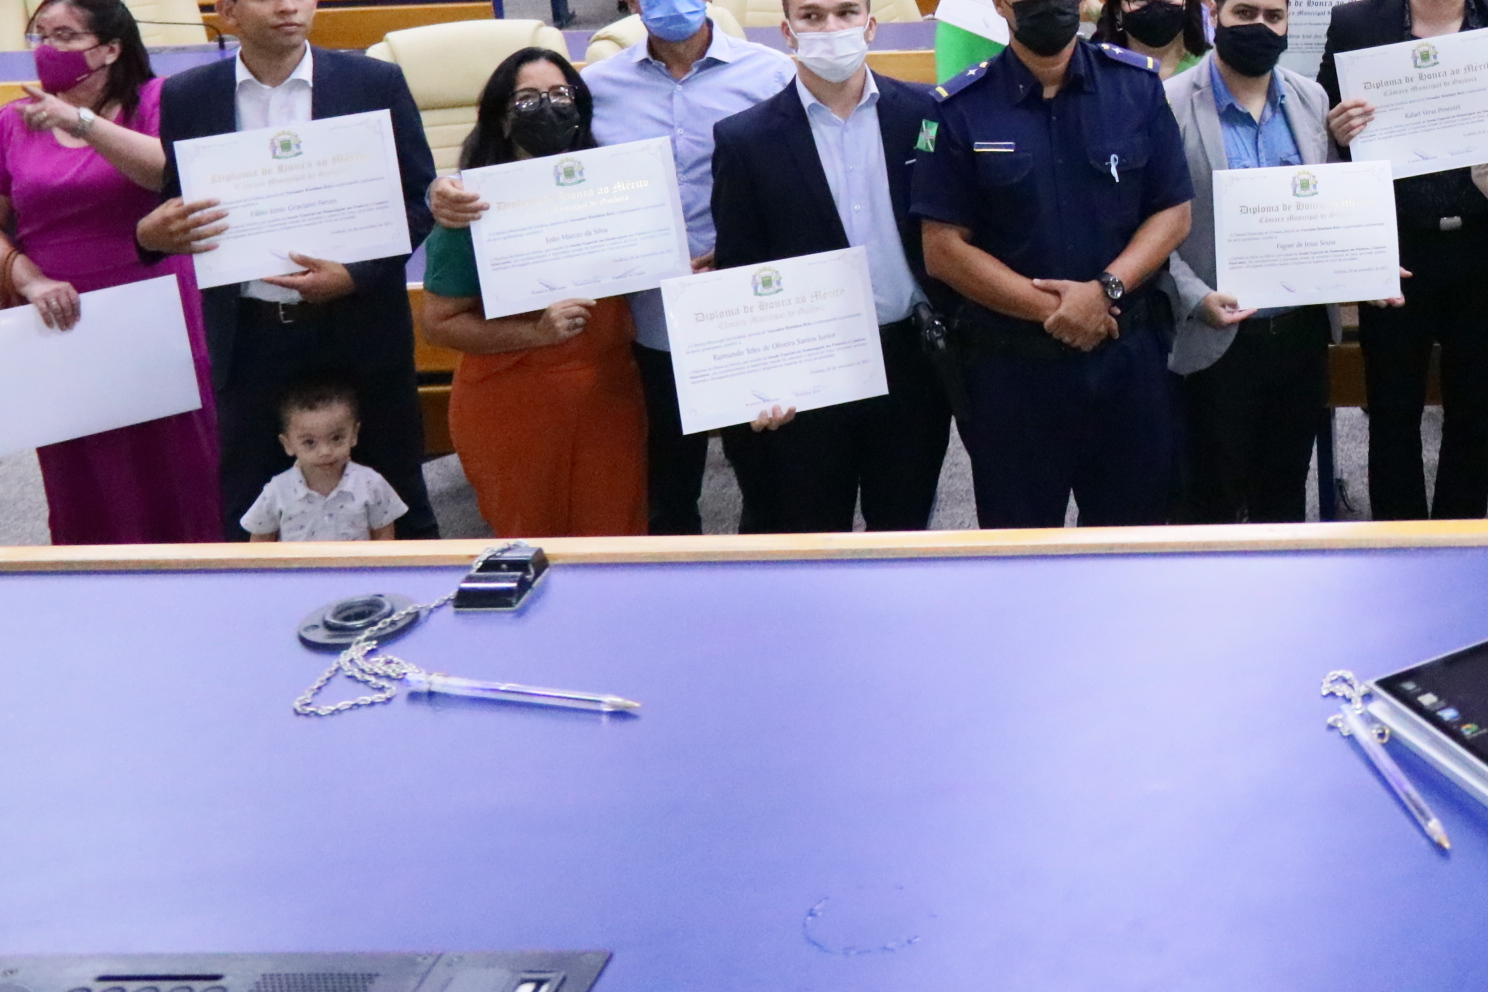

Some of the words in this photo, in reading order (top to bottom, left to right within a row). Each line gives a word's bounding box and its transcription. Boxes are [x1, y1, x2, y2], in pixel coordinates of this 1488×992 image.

[1363, 79, 1403, 90] Diploma
[1418, 71, 1448, 82] Honra
[1438, 104, 1461, 113] Pimentel
[597, 186, 610, 195] ao
[1240, 205, 1279, 215] Diploma
[695, 308, 740, 322] Diploma
[795, 296, 807, 305] ao
[713, 350, 744, 361] Raimundo
[772, 341, 796, 350] Oliveira
[797, 337, 817, 345] Santos
